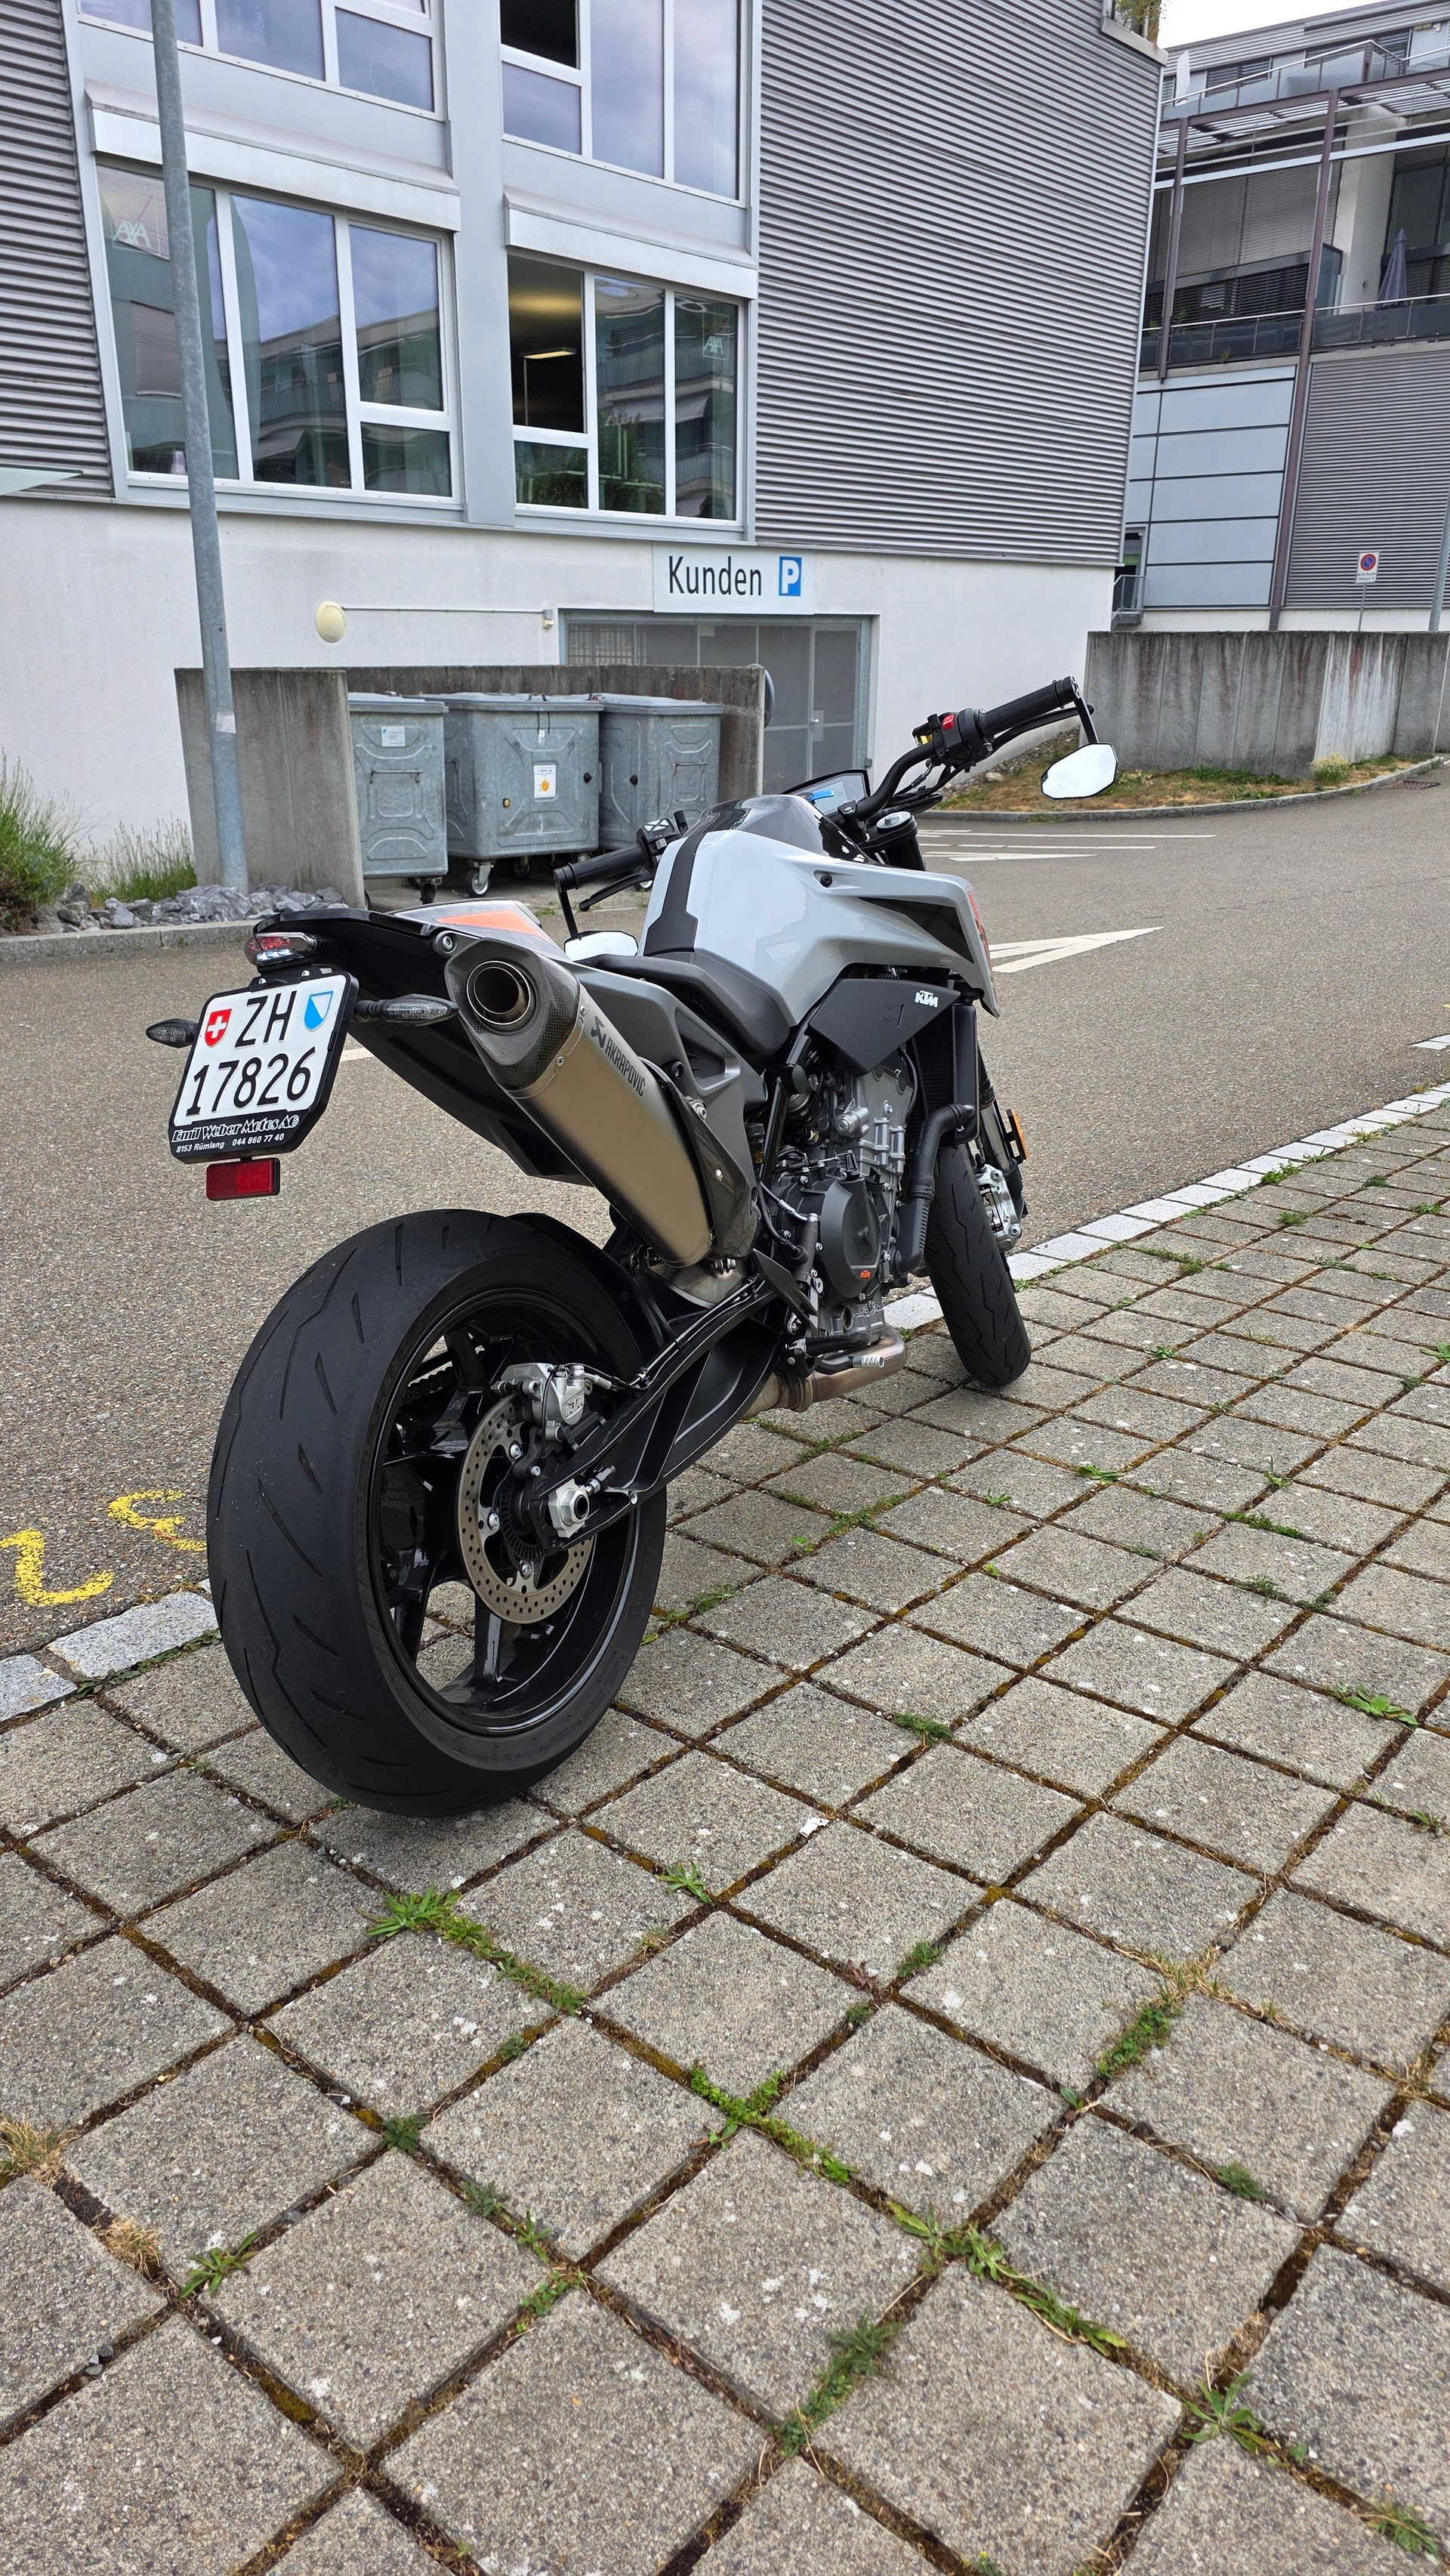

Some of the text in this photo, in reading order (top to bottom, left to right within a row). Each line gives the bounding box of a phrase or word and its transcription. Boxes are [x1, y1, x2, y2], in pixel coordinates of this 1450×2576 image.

[112, 221, 151, 248] AXA
[703, 335, 723, 355] AXA
[669, 556, 800, 596] Kunden P
[915, 990, 939, 1008] KTM
[235, 990, 297, 1049] ZH
[186, 1046, 316, 1117] 17826
[171, 1126, 202, 1142] Emil
[202, 1123, 242, 1140] Weber
[241, 1117, 279, 1134] Motos
[176, 1133, 285, 1153] 8153 Rümlang 044 860 77 40
